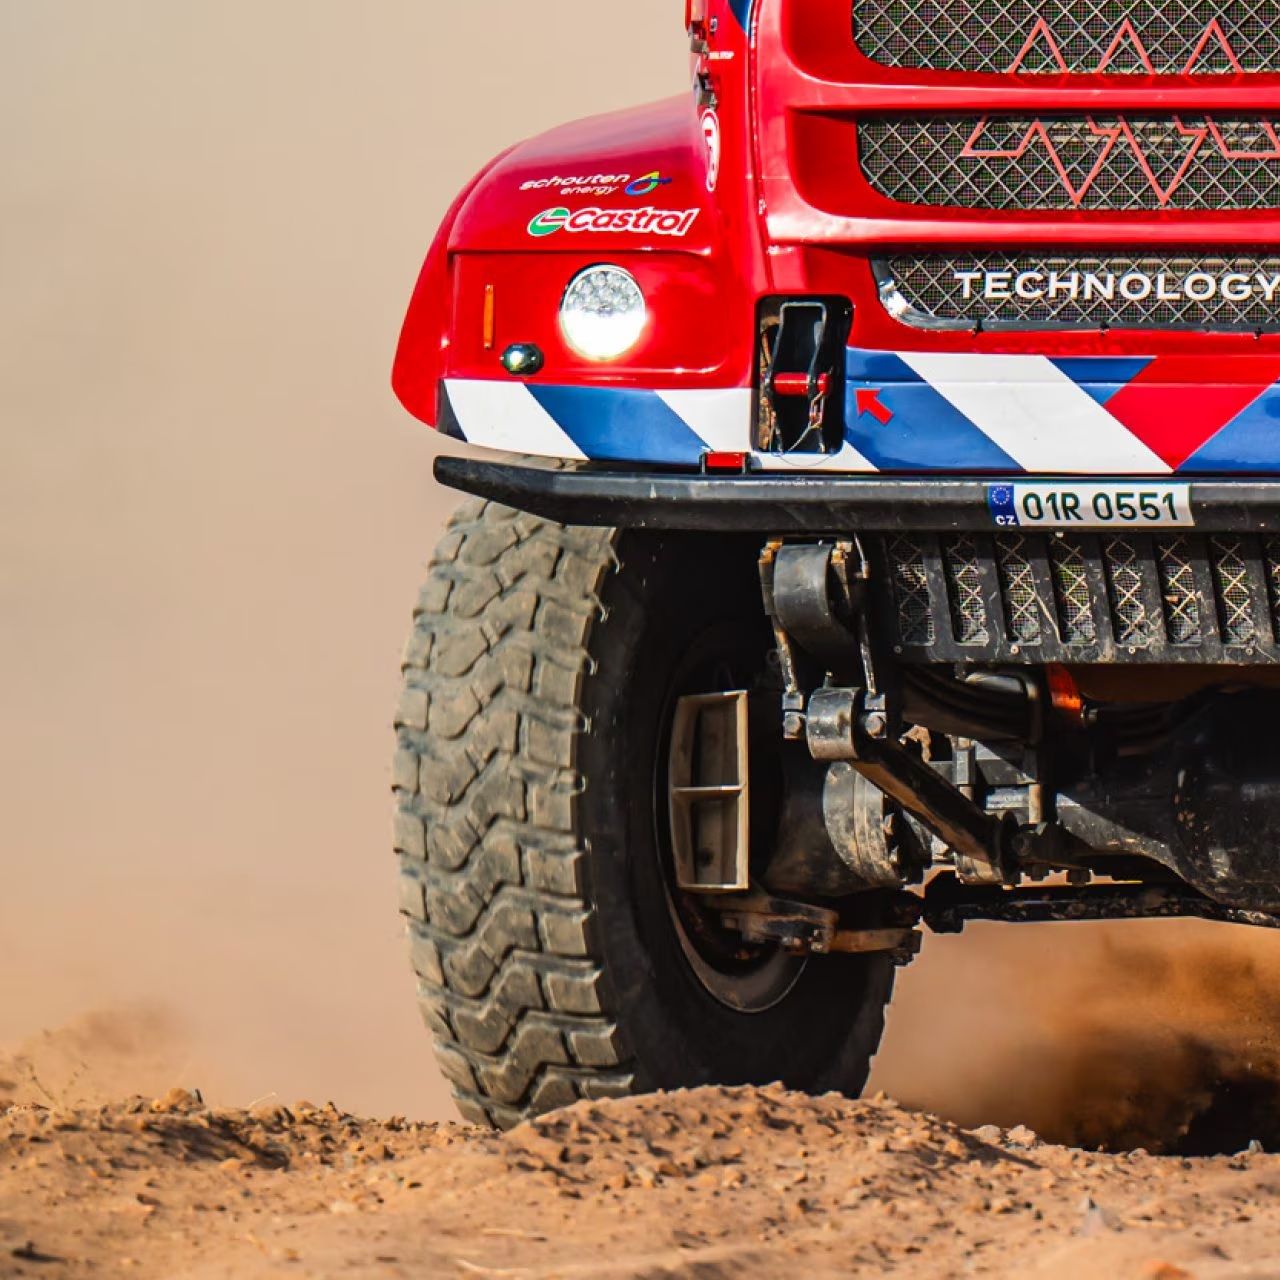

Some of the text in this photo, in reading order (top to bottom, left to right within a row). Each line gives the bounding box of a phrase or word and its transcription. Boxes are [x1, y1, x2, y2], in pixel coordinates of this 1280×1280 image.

[519, 174, 630, 190] schouten
[560, 185, 619, 196] energy
[565, 206, 700, 236] Castrol
[995, 489, 1179, 526] CZ 01R 0551
